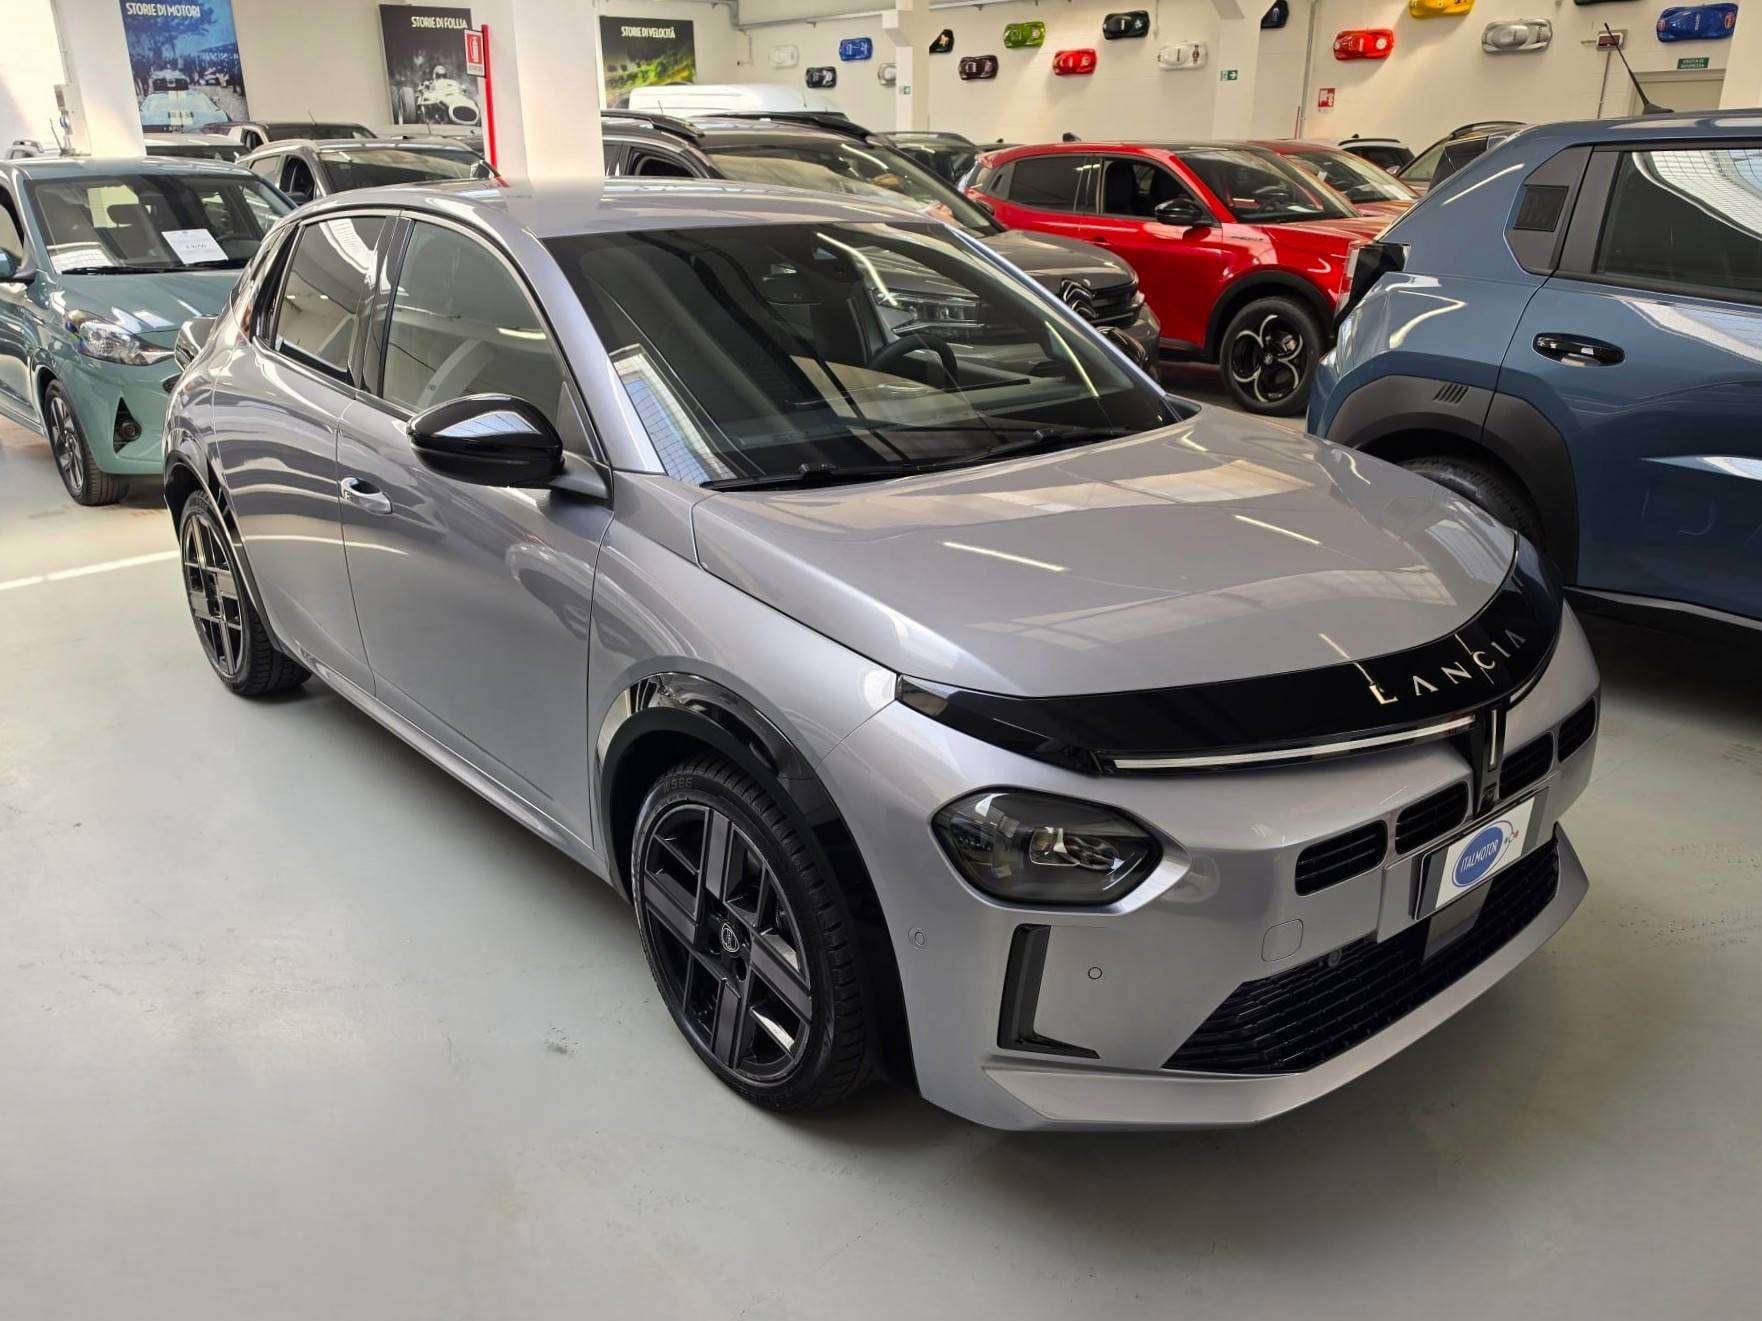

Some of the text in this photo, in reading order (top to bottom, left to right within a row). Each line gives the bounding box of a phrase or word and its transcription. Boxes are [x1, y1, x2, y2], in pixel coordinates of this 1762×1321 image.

[126, 3, 201, 17] STORIE DI MOTORI
[411, 16, 468, 29] STORIE DI FOLLIA
[1369, 629, 1527, 704] LANCIA
[1460, 838, 1499, 873] ITALMOTOR
